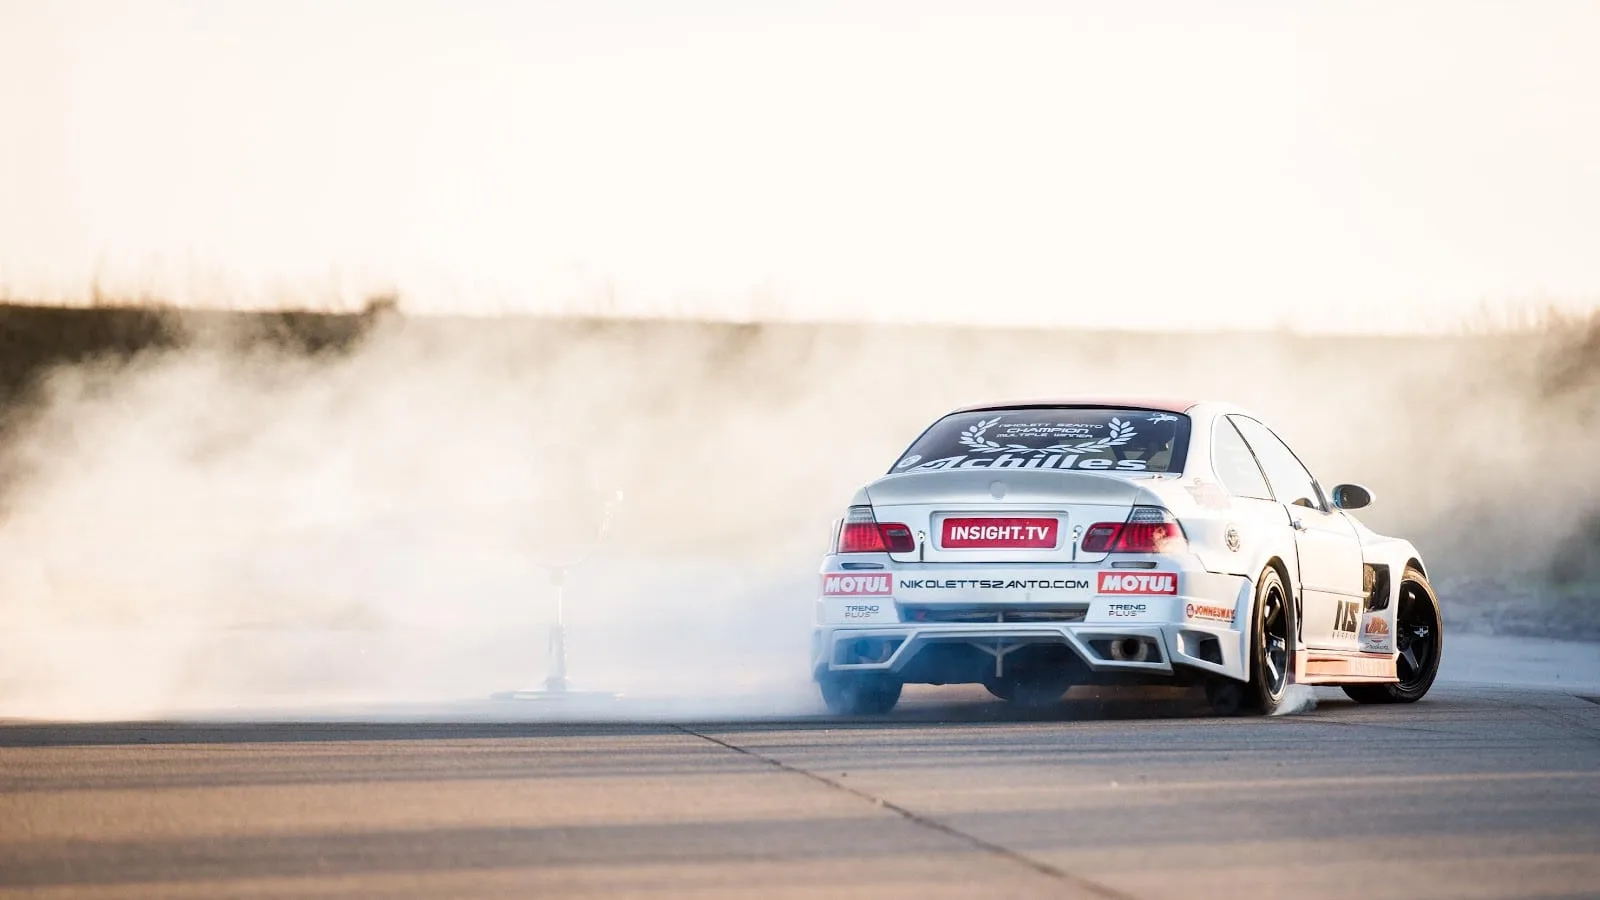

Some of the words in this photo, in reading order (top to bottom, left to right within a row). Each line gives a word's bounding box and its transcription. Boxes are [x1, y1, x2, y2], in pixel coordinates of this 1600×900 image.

[950, 526, 1050, 541] INSIGHT.TV
[824, 576, 890, 593] MOTUL
[1100, 574, 1176, 592] MOTUL
